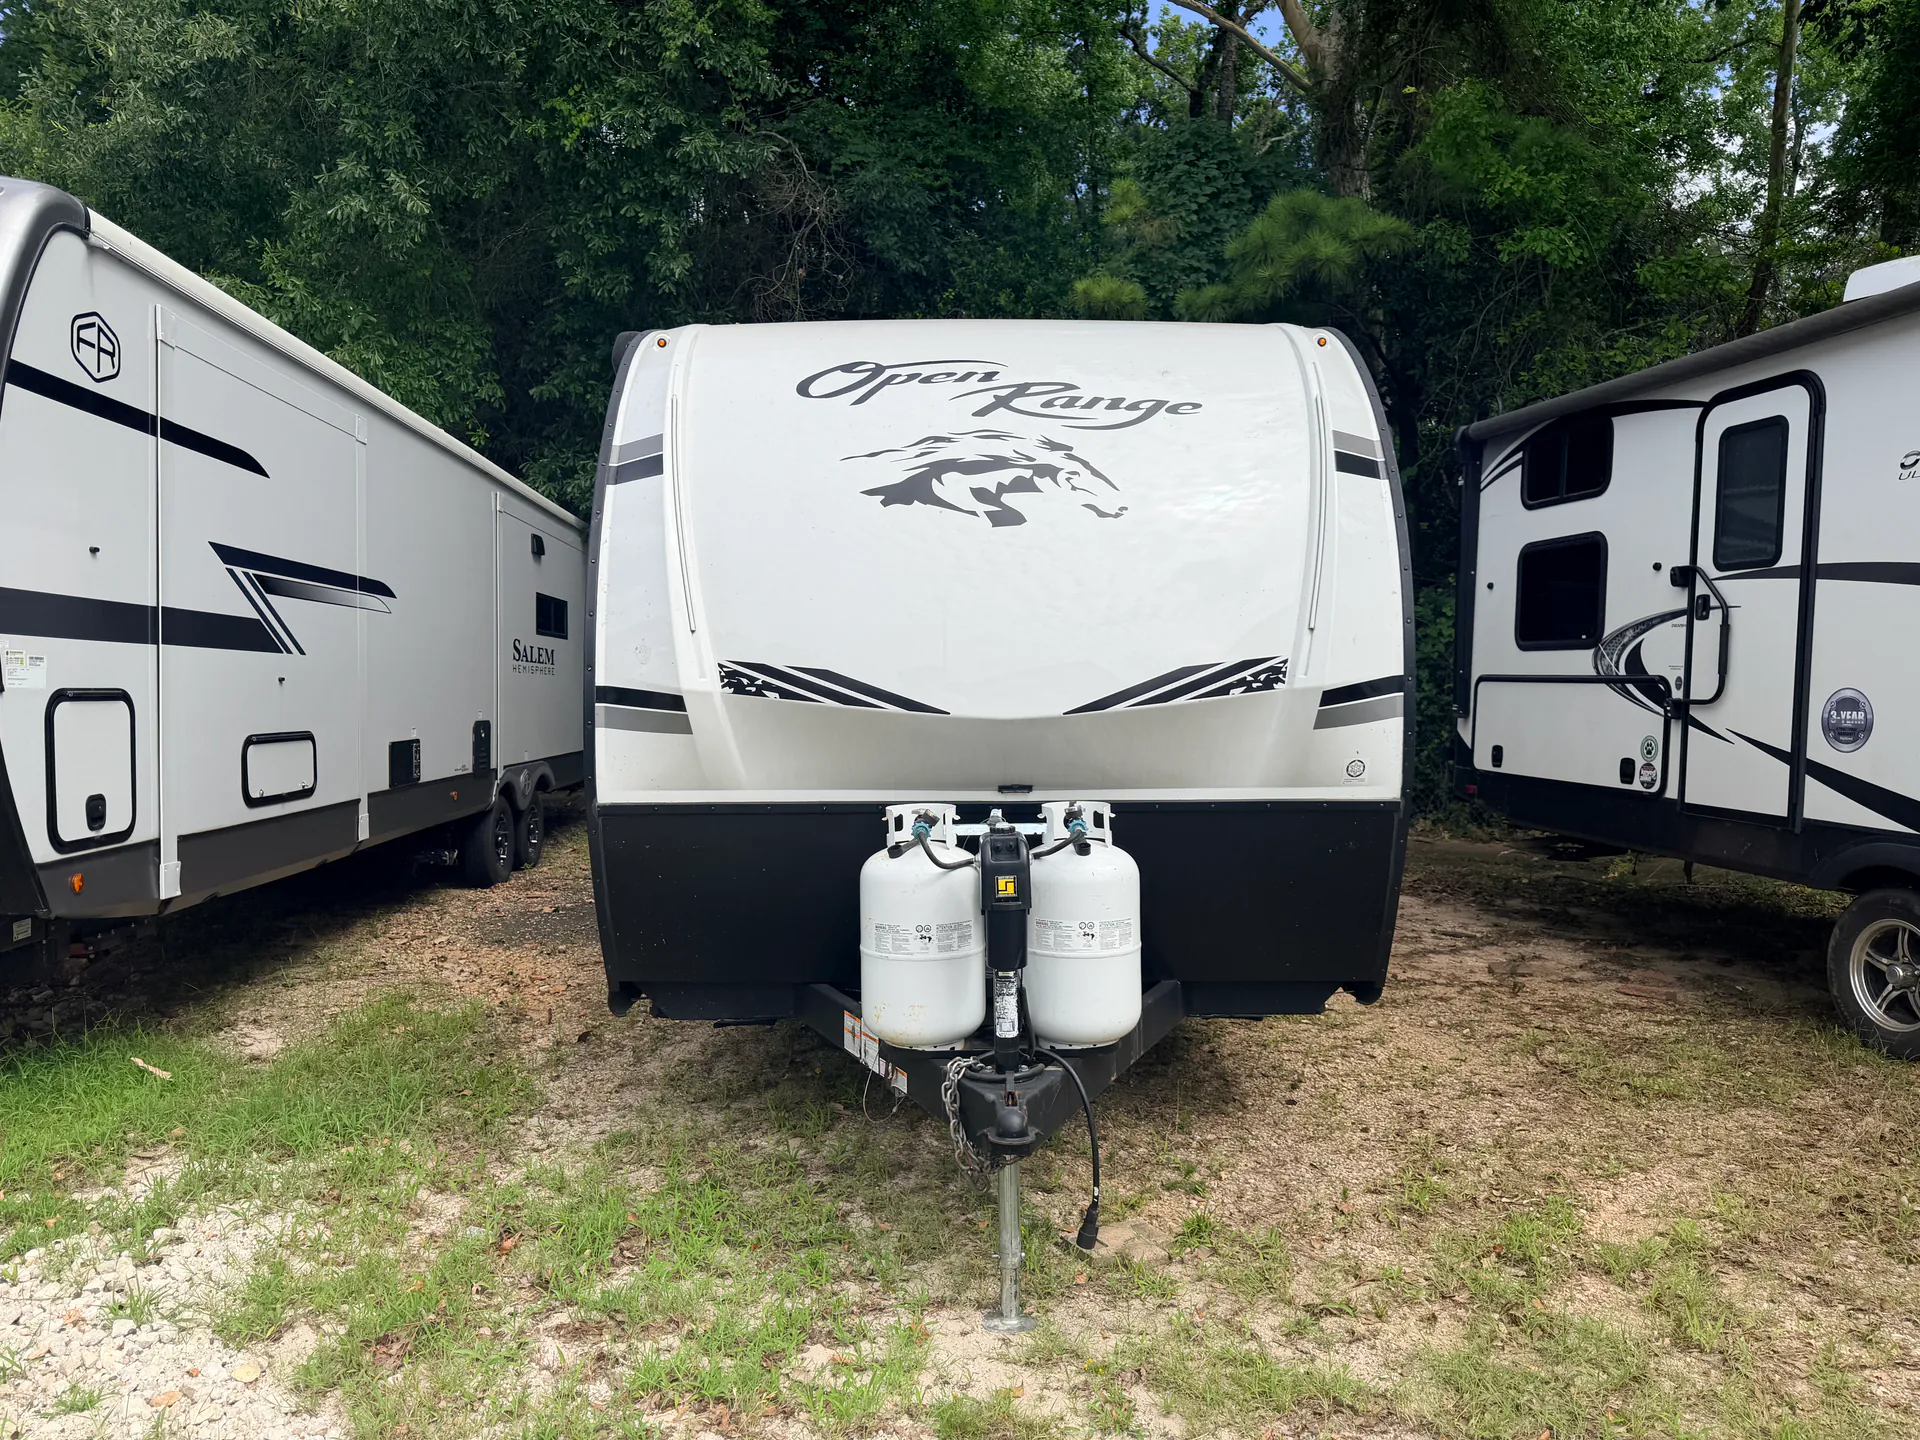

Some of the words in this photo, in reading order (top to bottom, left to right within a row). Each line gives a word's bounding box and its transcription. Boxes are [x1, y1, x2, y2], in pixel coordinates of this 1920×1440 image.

[796, 361, 1008, 406] Open
[949, 382, 1203, 430] Range
[512, 664, 555, 675] HEMISPHERE
